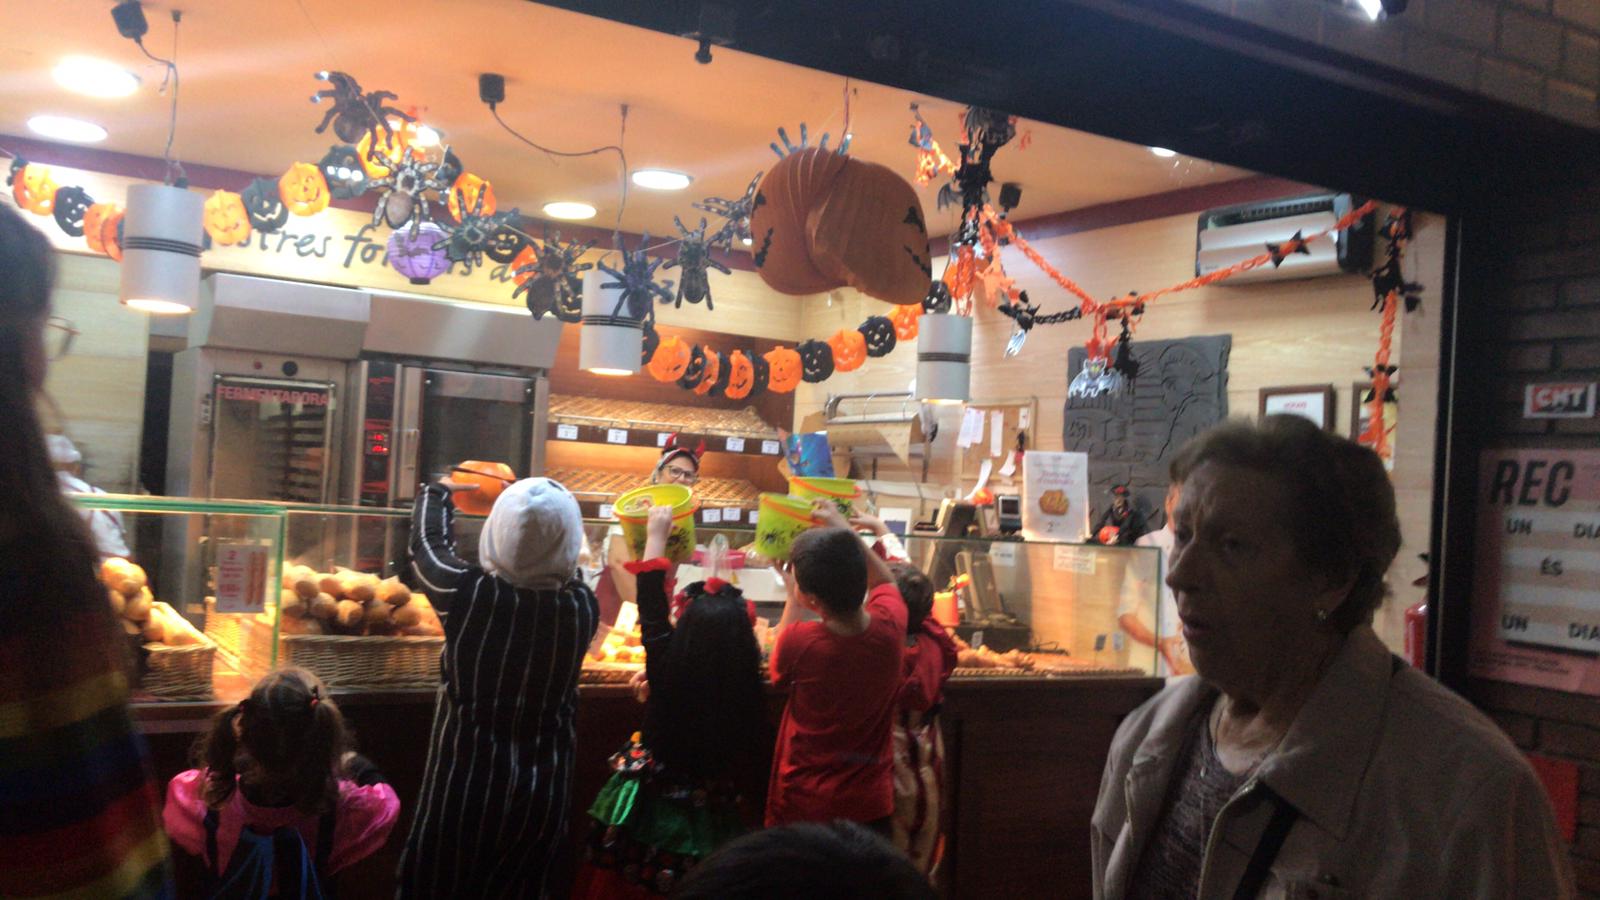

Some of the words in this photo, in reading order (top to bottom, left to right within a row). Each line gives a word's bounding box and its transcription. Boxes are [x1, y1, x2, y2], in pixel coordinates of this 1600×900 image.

[215, 384, 330, 406] FERMENTADORA
[1490, 458, 1574, 508] REC
[1506, 517, 1534, 535] UN
[1502, 614, 1530, 632] UN
